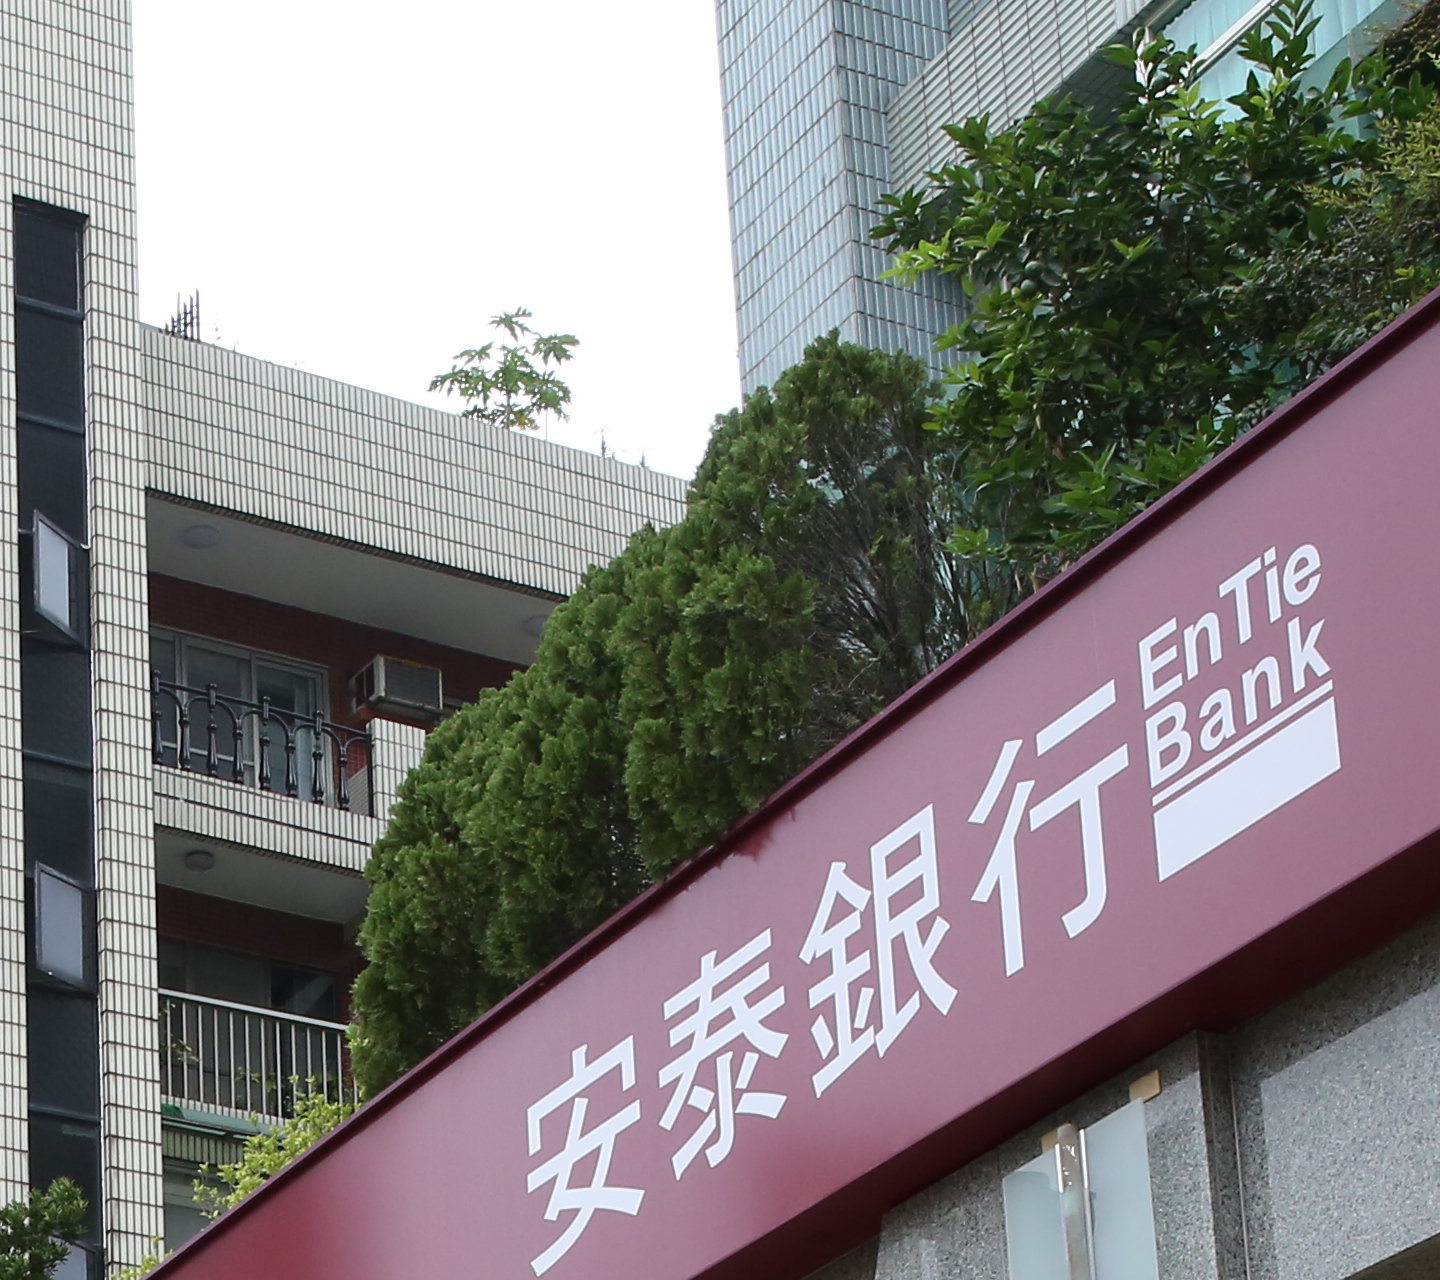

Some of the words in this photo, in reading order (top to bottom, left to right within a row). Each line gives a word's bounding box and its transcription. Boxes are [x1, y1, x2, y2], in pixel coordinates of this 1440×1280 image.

[1140, 543, 1322, 710] EnTie
[1144, 619, 1332, 790] Bank
[527, 678, 1129, 1278] 安泰銀行
